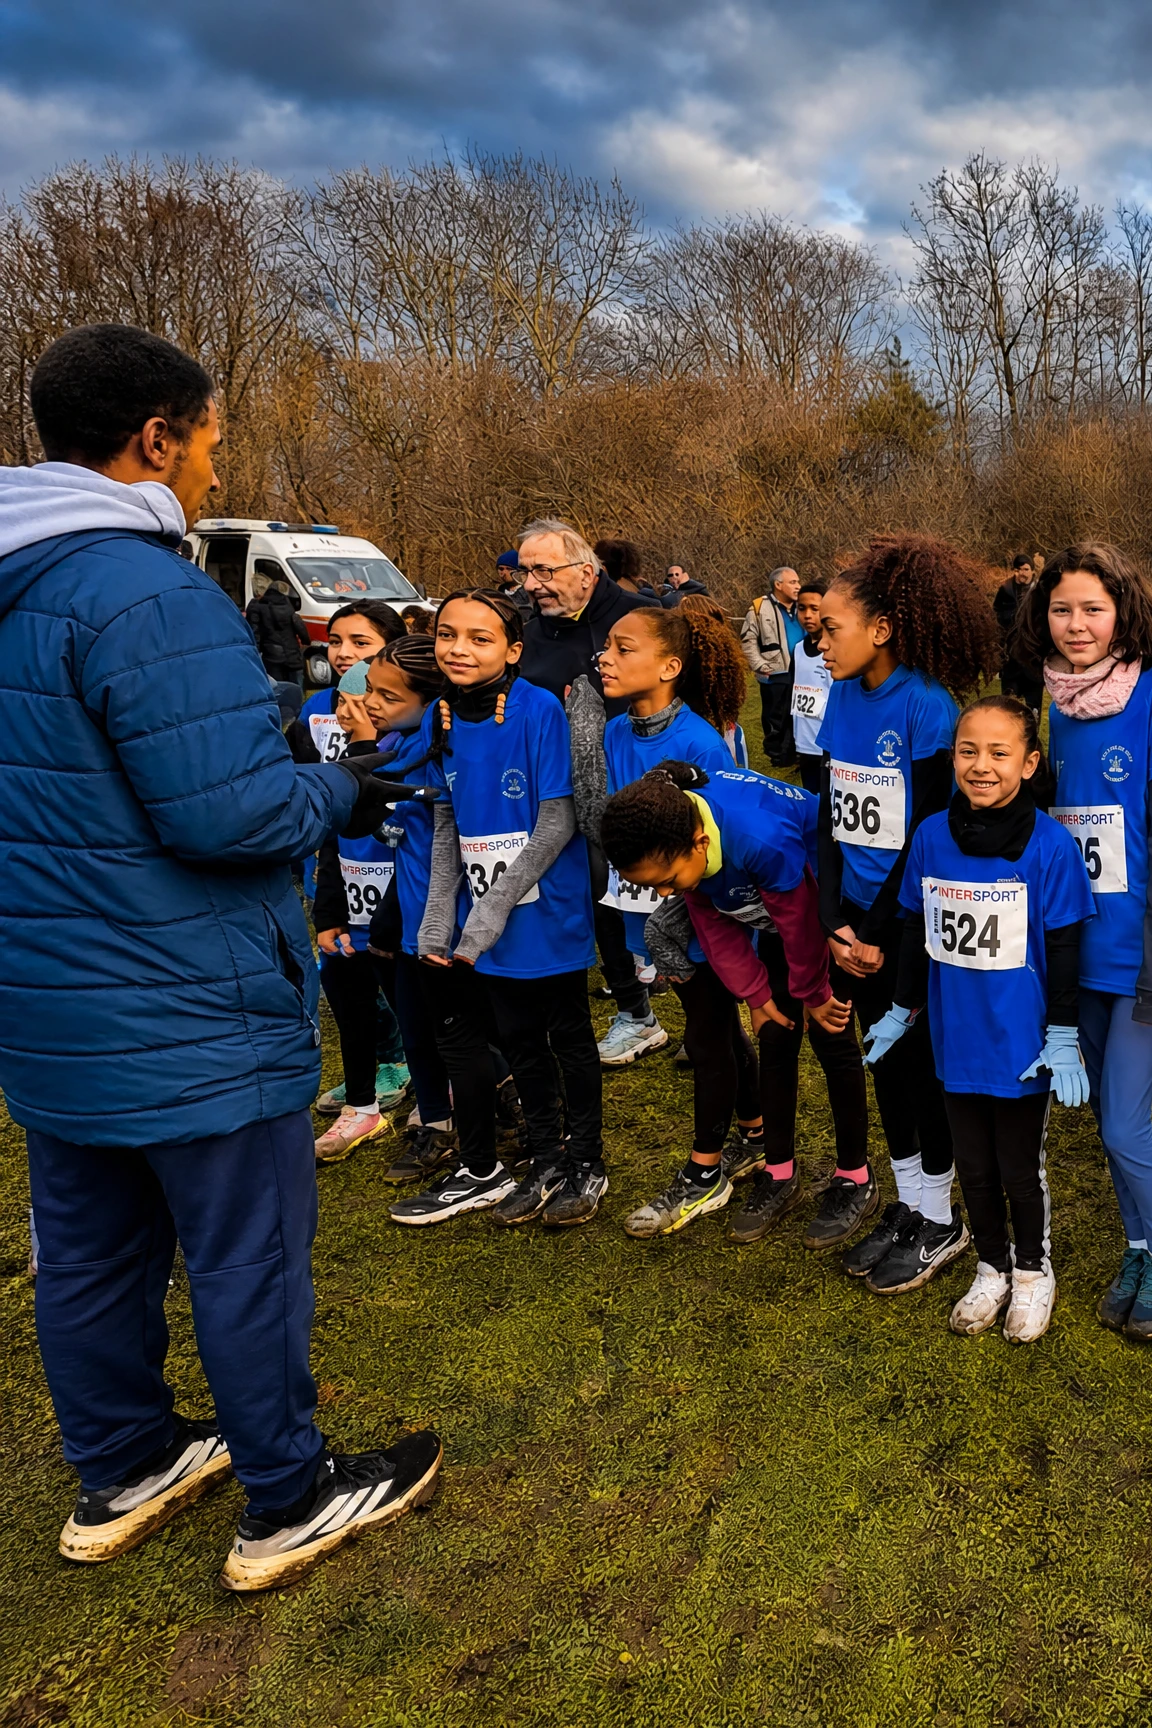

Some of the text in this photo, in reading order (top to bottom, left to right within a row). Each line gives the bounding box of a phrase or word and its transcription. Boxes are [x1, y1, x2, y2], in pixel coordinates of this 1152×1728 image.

[832, 789, 880, 835] 536
[938, 886, 1019, 902] INTERSPORT
[941, 909, 1001, 958] 524
